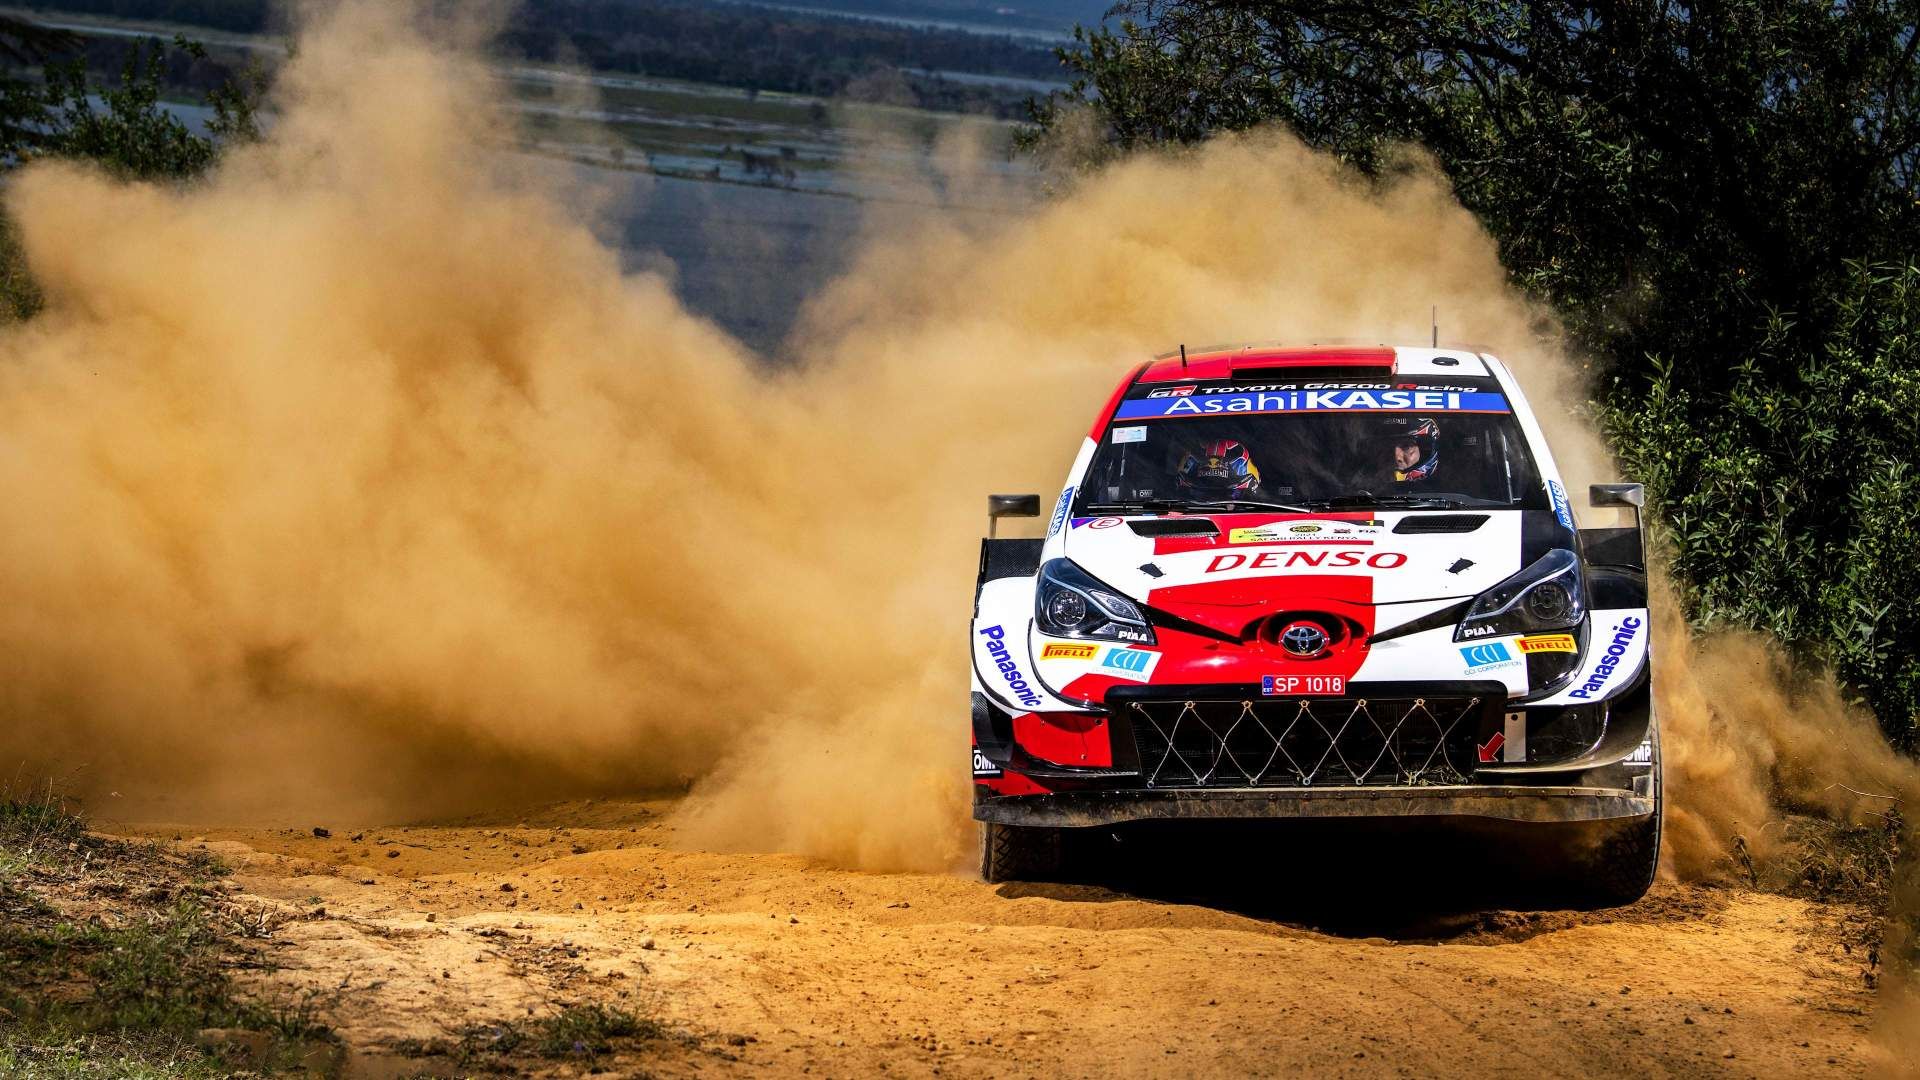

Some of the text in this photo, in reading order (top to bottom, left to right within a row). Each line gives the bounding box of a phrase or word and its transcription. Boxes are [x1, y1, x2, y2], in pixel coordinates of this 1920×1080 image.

[1150, 386, 1193, 398] GR
[1202, 382, 1478, 394] TOYOTA GAZOO Racing
[1204, 551, 1408, 574] DENSO
[1117, 629, 1148, 642] PIAA
[1463, 624, 1497, 638] PIAA
[1043, 644, 1096, 658] PIRELLI
[1519, 637, 1573, 651] PIRELLI
[1568, 616, 1641, 699] Panasonic
[980, 624, 1042, 707] Panasonic
[1275, 677, 1300, 693] SP
[1305, 676, 1343, 693] 1018
